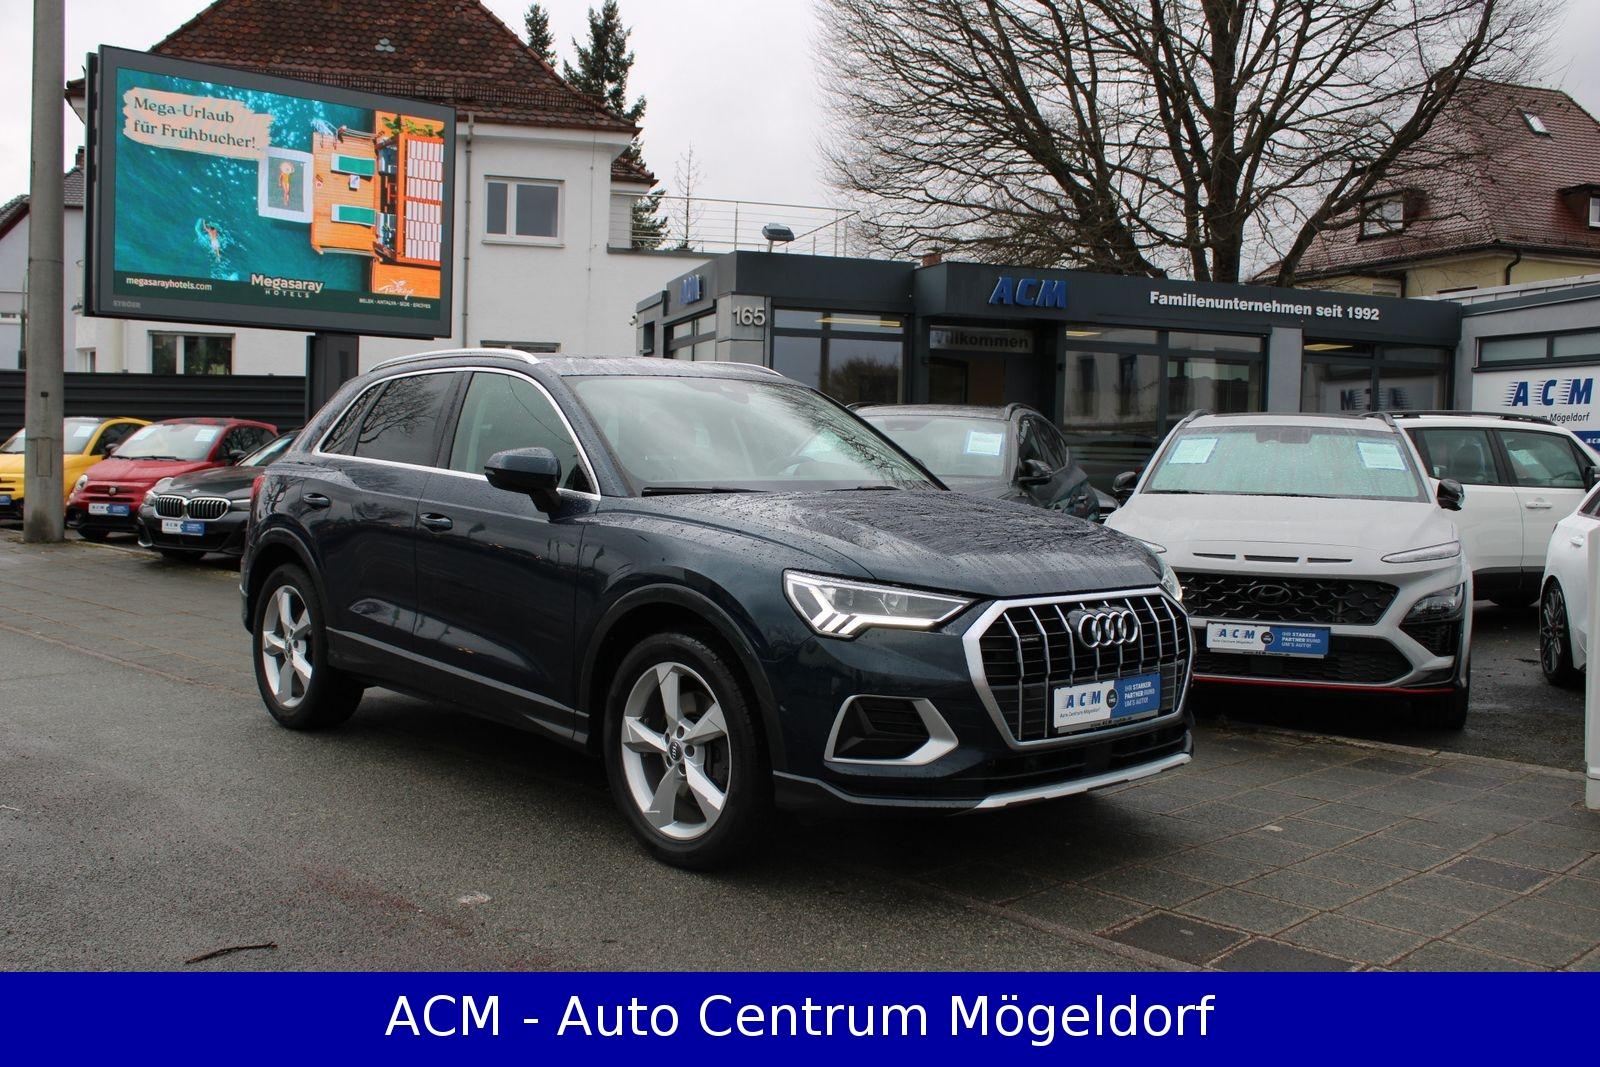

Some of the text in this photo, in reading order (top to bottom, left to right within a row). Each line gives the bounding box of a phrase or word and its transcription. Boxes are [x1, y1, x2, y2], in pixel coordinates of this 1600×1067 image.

[134, 96, 234, 123] Mega-Urlaub
[133, 119, 256, 149] für Frühbucher!
[126, 277, 213, 291] megasarayhotels.com
[251, 273, 324, 293] Megasaray
[988, 276, 1067, 308] ACM
[265, 289, 310, 299] HOTELS
[1150, 290, 1380, 321] Familienunternehmen seit 1992
[732, 306, 766, 326] 165
[1502, 378, 1594, 407] ACM
[1549, 412, 1590, 423] Mögeldorf
[1219, 629, 1255, 640] ACM
[1065, 690, 1102, 709] ACM
[1124, 691, 1144, 700] PARTNER
